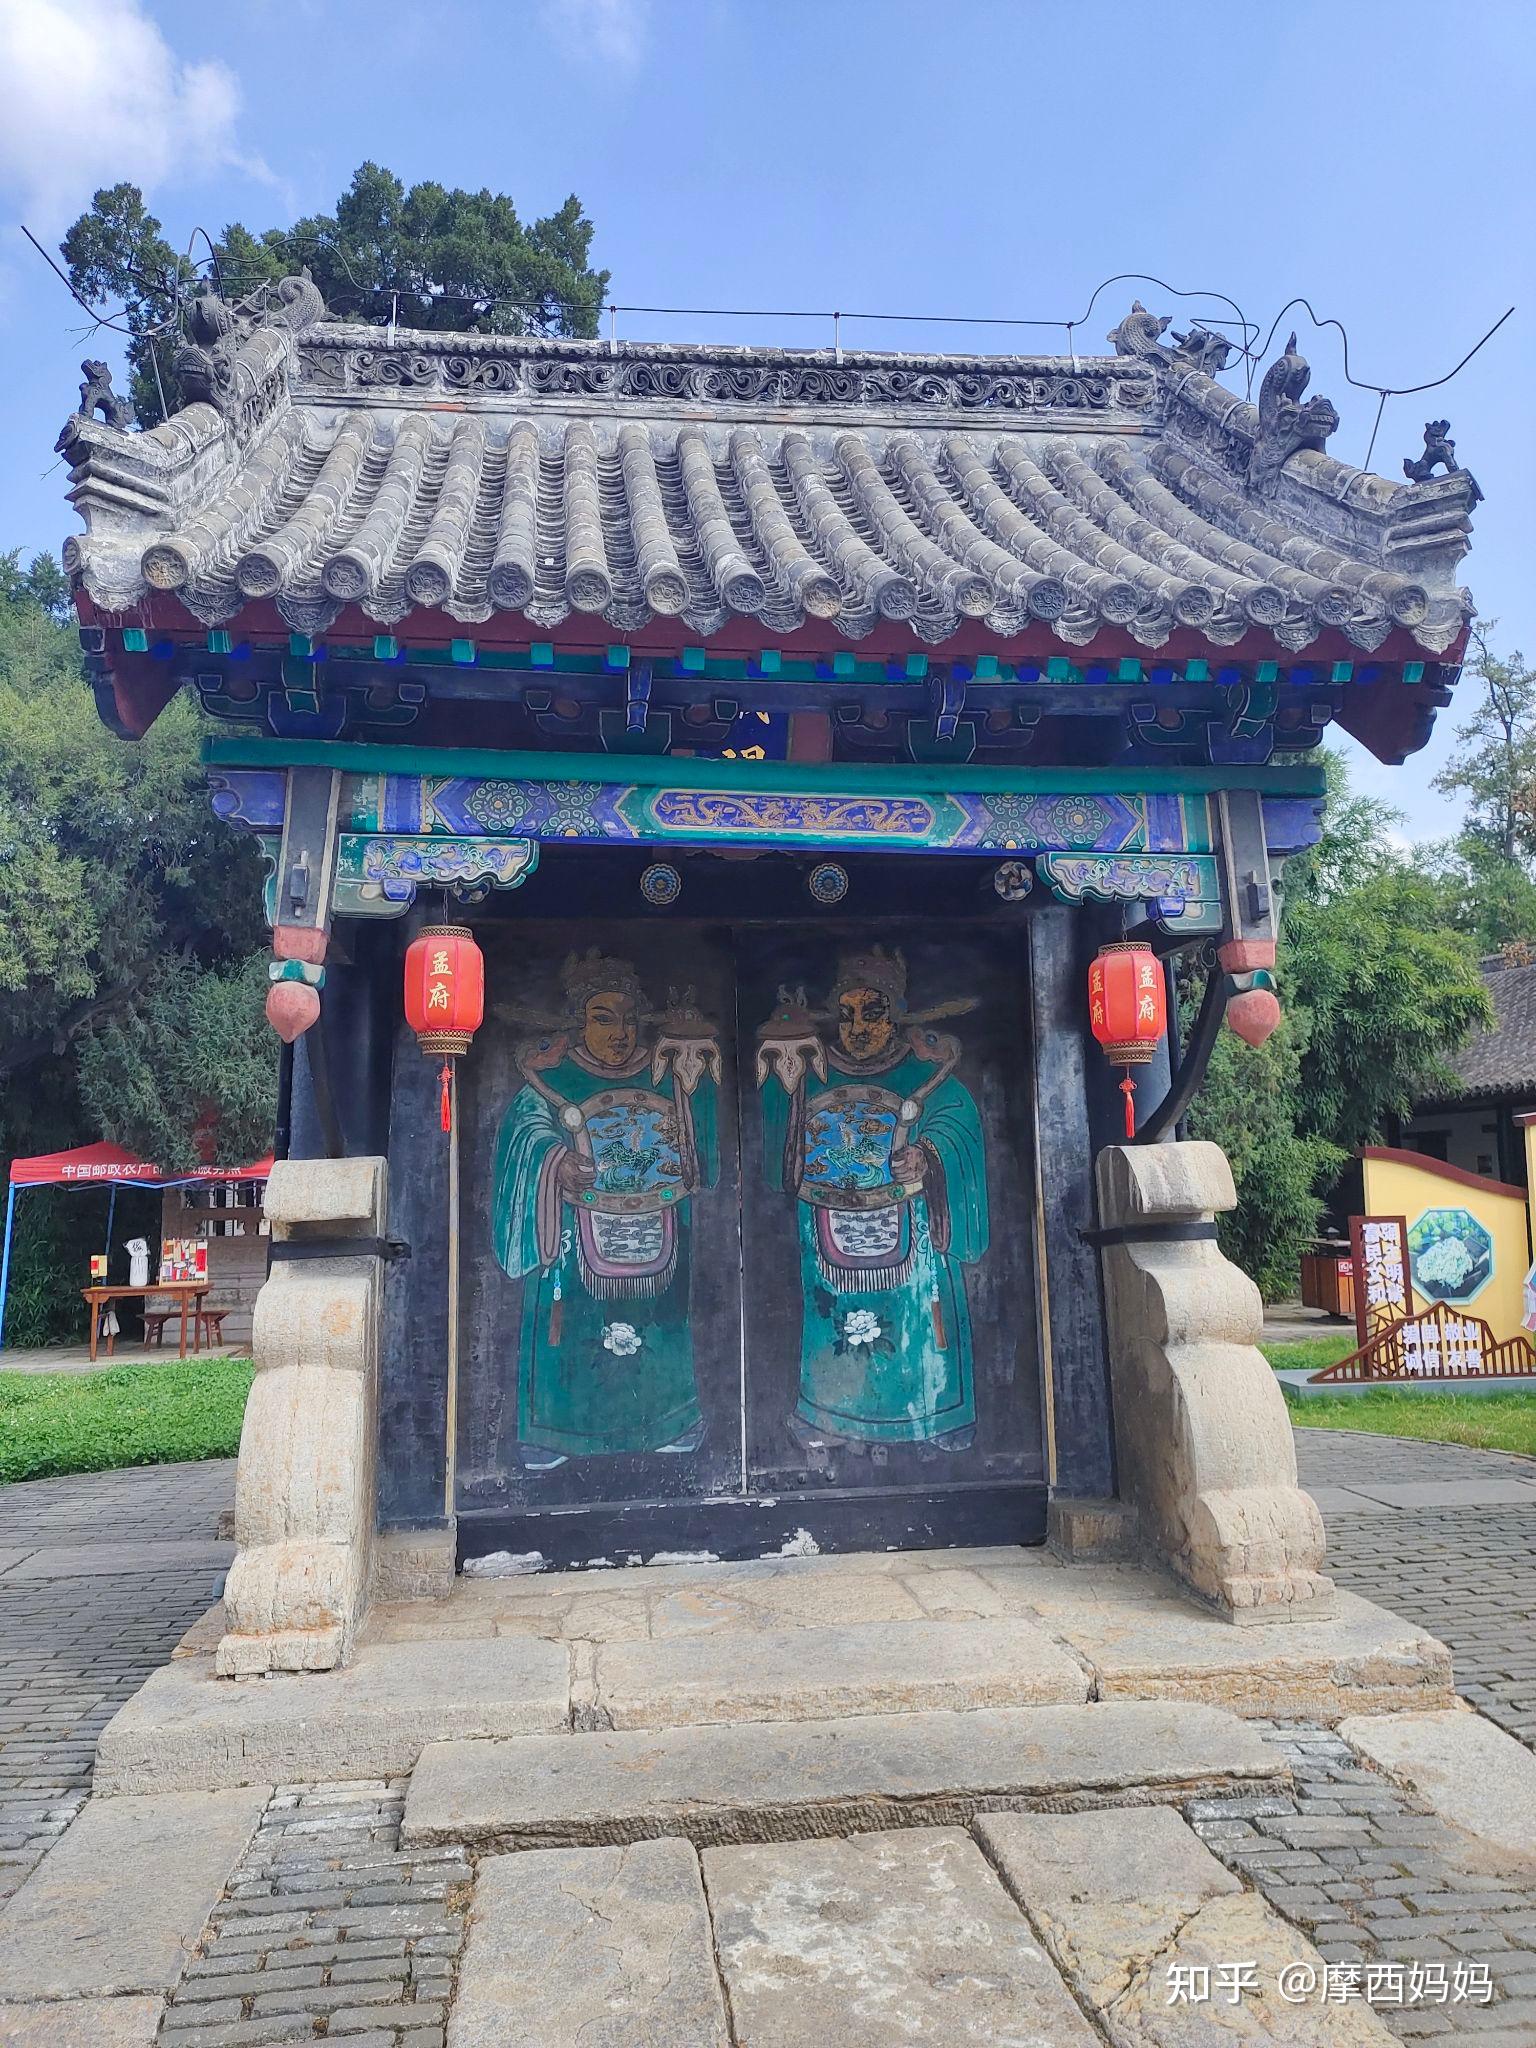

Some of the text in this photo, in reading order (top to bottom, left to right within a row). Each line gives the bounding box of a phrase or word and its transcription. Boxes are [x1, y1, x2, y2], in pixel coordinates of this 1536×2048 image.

[428, 950, 453, 1010] 孟府
[1092, 970, 1104, 1025] 孟府
[1138, 965, 1158, 1022] 孟府
[1447, 1349, 1482, 1369] 友善
